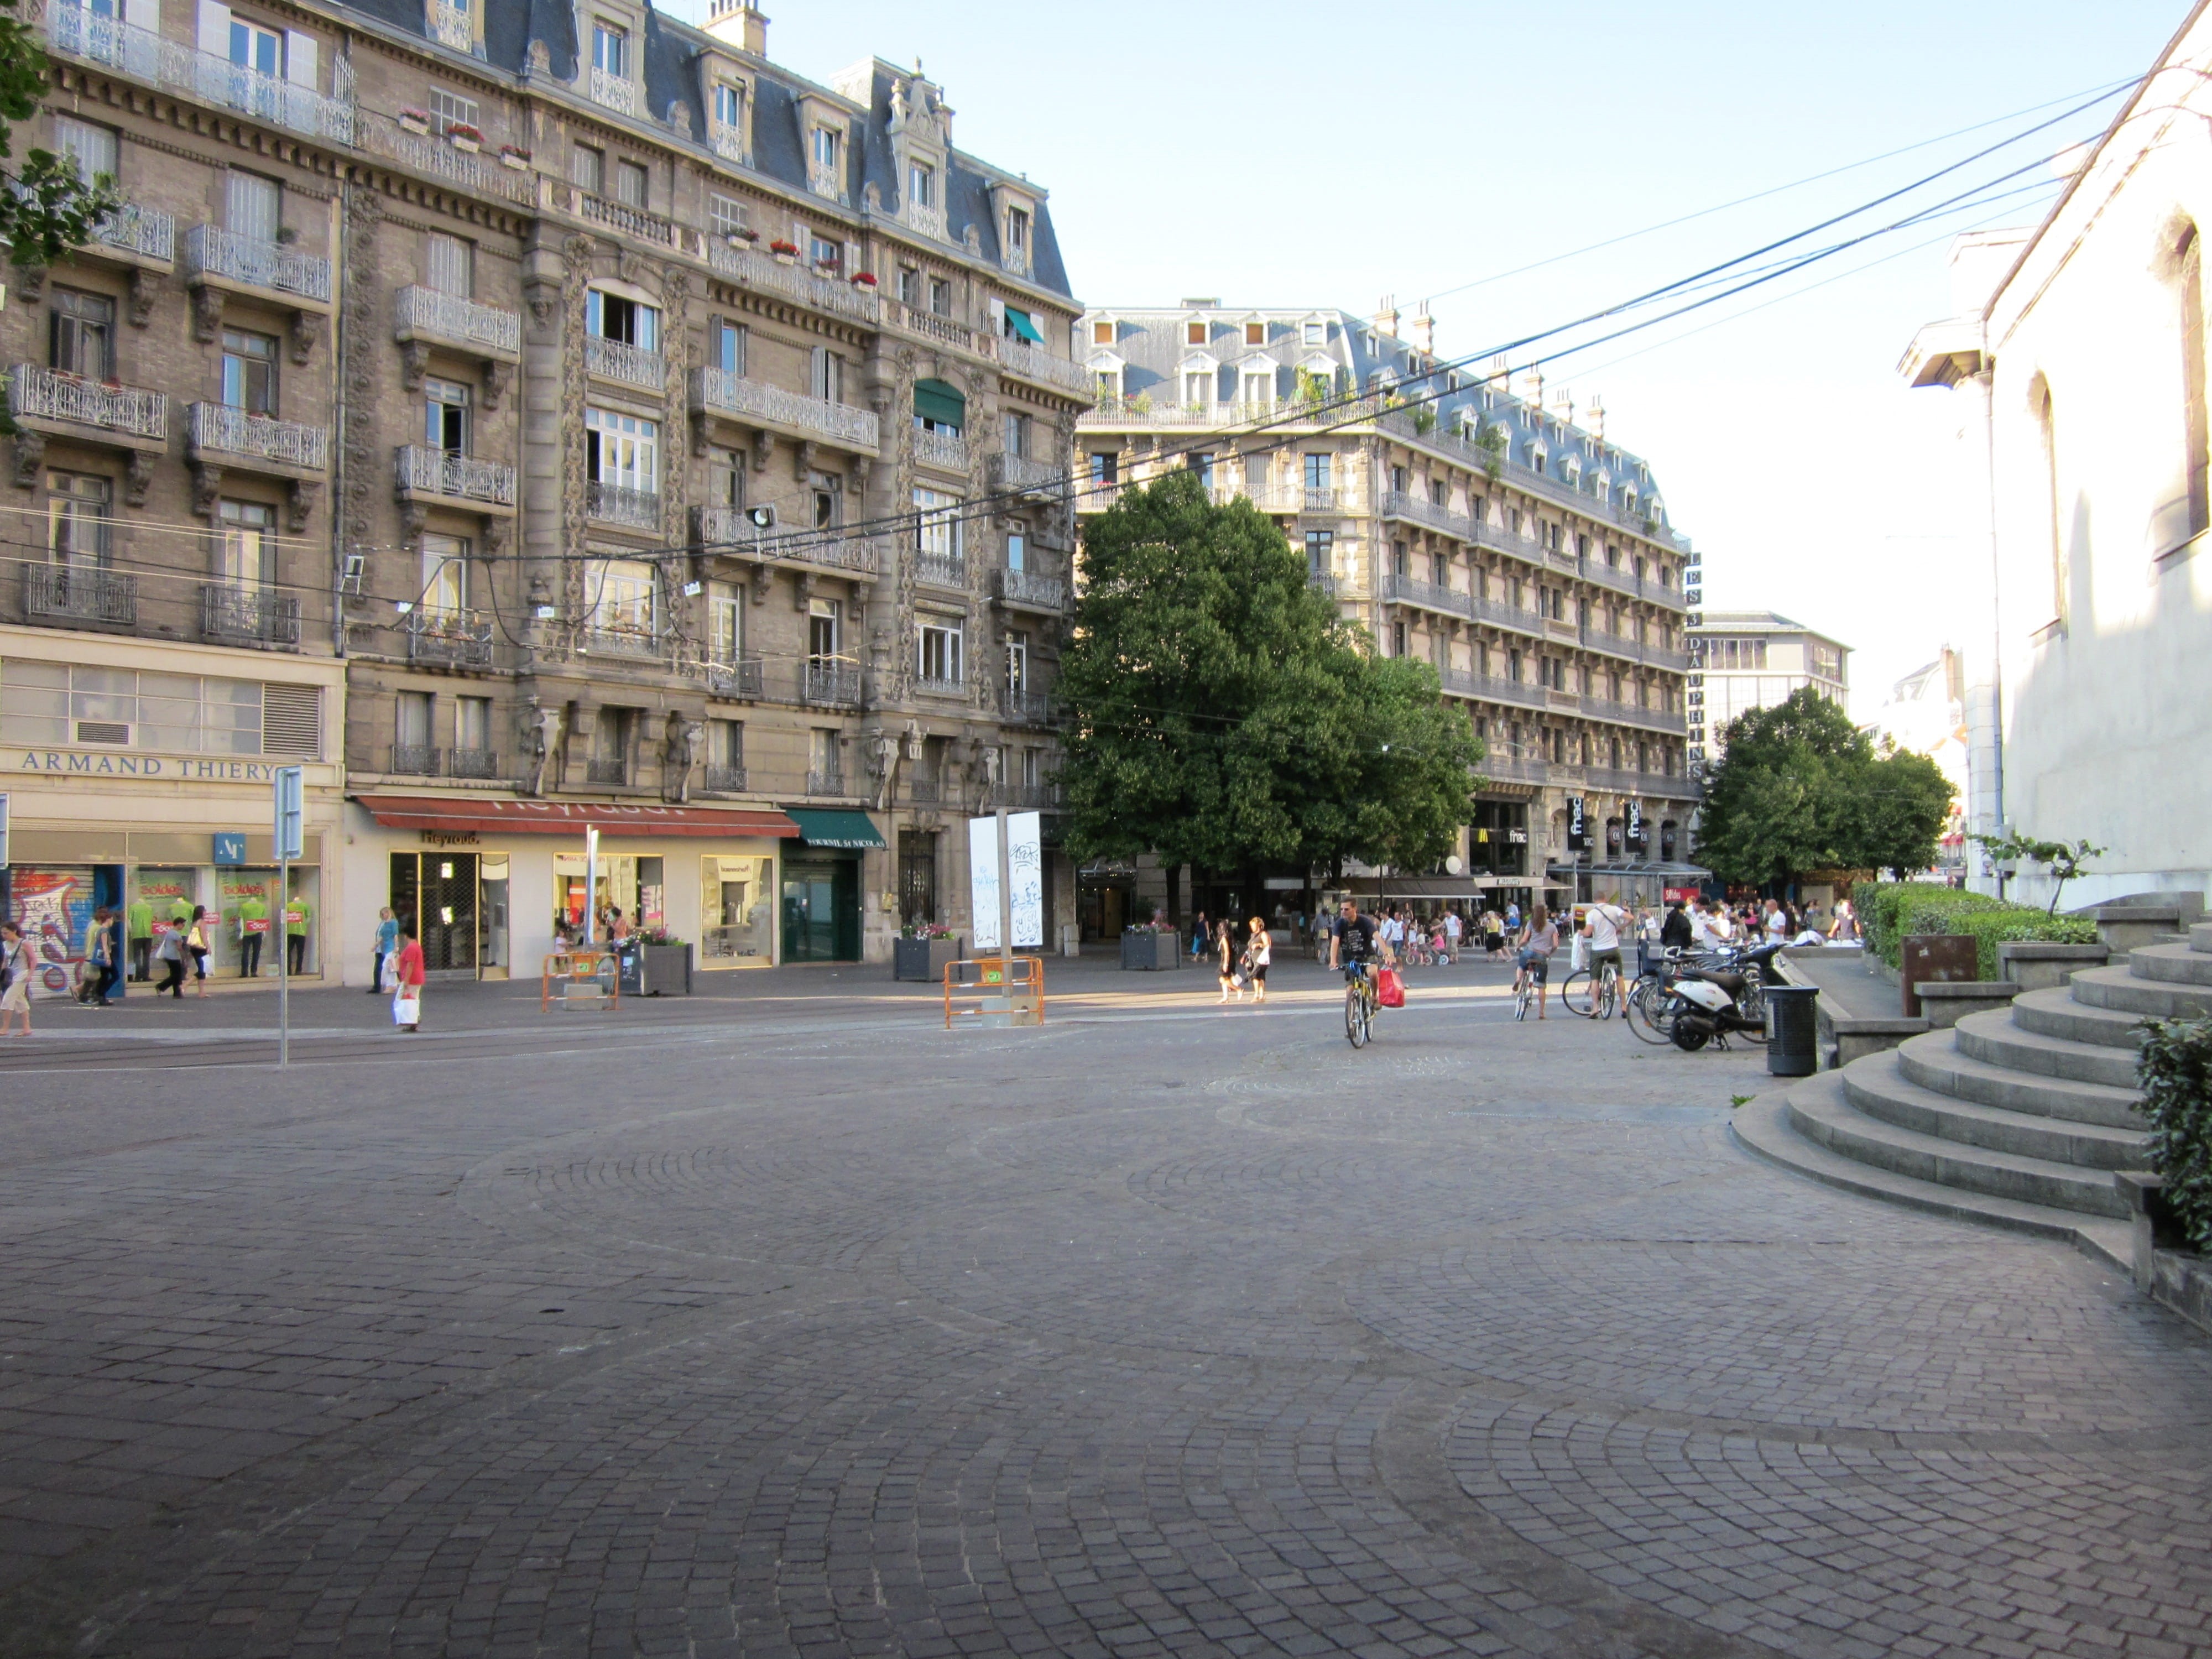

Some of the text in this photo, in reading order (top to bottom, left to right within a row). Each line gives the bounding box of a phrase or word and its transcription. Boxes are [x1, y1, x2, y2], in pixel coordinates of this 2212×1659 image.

[1689, 554, 1702, 777] LES 3 DAUPHINS
[21, 752, 275, 780] ARMAND THIERY
[1571, 798, 1582, 834] fnac
[1628, 802, 1639, 837] fnac
[1510, 831, 1527, 843] fnac
